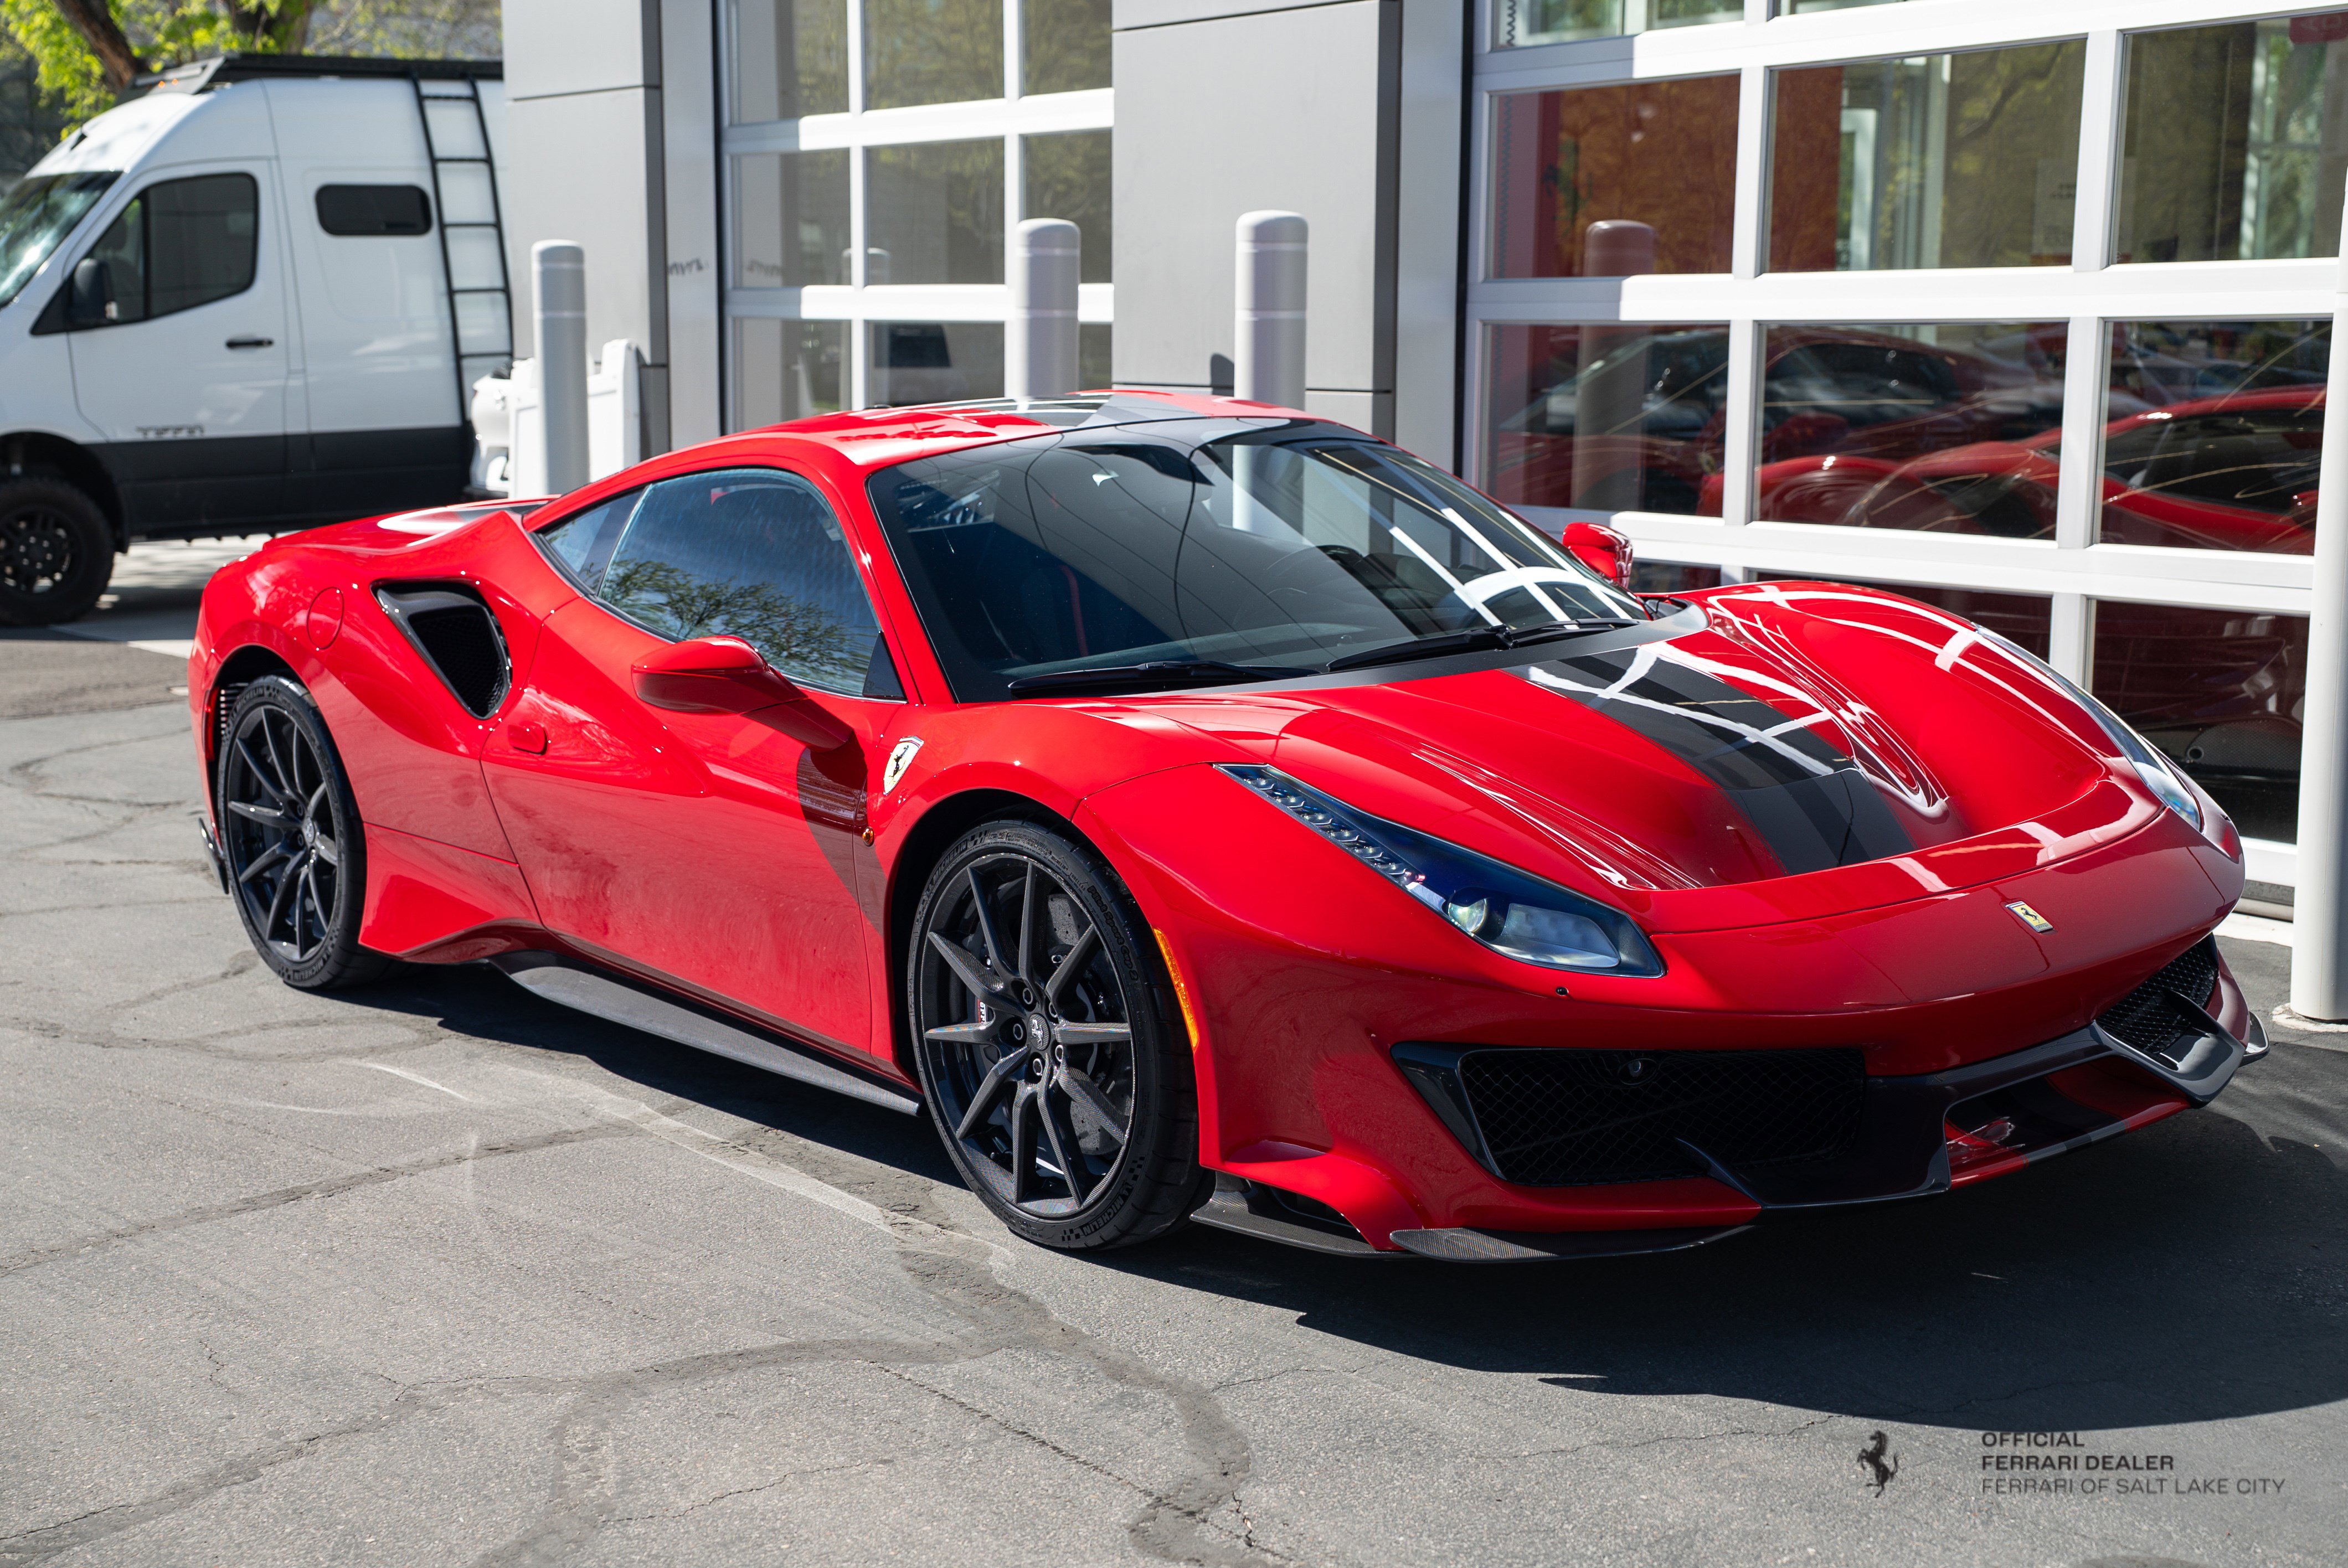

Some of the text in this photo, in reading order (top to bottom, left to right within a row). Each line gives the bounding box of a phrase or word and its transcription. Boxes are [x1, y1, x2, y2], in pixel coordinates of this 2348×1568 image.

[933, 839, 967, 883] MICHELIN
[1087, 885, 1139, 981] Pilot Sport Cup 2
[1082, 1196, 1124, 1236] MICHELIN
